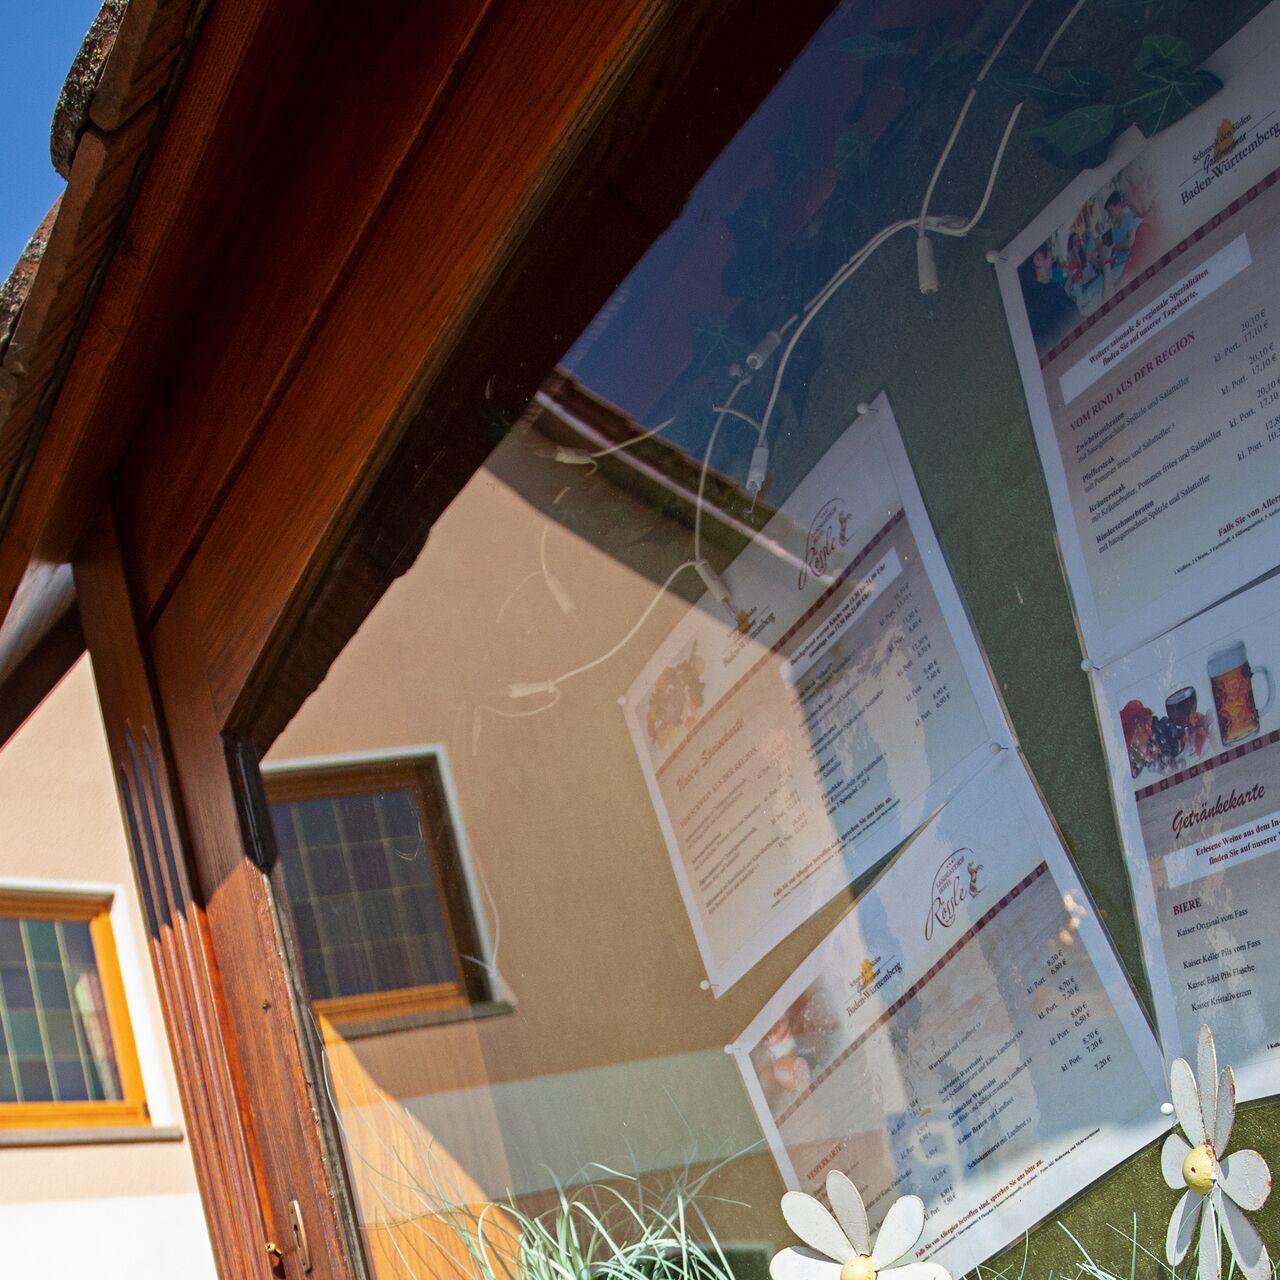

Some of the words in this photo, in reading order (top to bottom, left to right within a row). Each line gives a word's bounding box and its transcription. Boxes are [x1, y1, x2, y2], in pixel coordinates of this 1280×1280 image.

[1089, 344, 1111, 364] Weitere
[1142, 299, 1169, 323] regionale
[1120, 341, 1130, 352] Sie
[1130, 331, 1140, 344] auf
[1070, 409, 1092, 432] VOM
[1091, 391, 1115, 415] RIND
[1115, 376, 1134, 398] AUS
[1134, 360, 1155, 383] DER
[1155, 330, 1195, 367] REGION
[1217, 522, 1234, 536] Falls
[1234, 516, 1246, 526] Sie
[1246, 508, 1260, 519] von
[1171, 783, 1266, 839] Getränkekarte
[1195, 842, 1222, 856] Erlesene
[1222, 834, 1243, 846] Weine
[1244, 829, 1256, 838] aus
[1256, 823, 1271, 833] dem
[1208, 853, 1229, 865] finden
[1229, 848, 1240, 857] Sie
[1240, 843, 1252, 853] auf
[1252, 835, 1278, 849] unserer
[1172, 897, 1201, 915] BIERE
[1234, 909, 1248, 918] Fass
[1202, 953, 1220, 963] Keller
[1247, 940, 1261, 949] Fass
